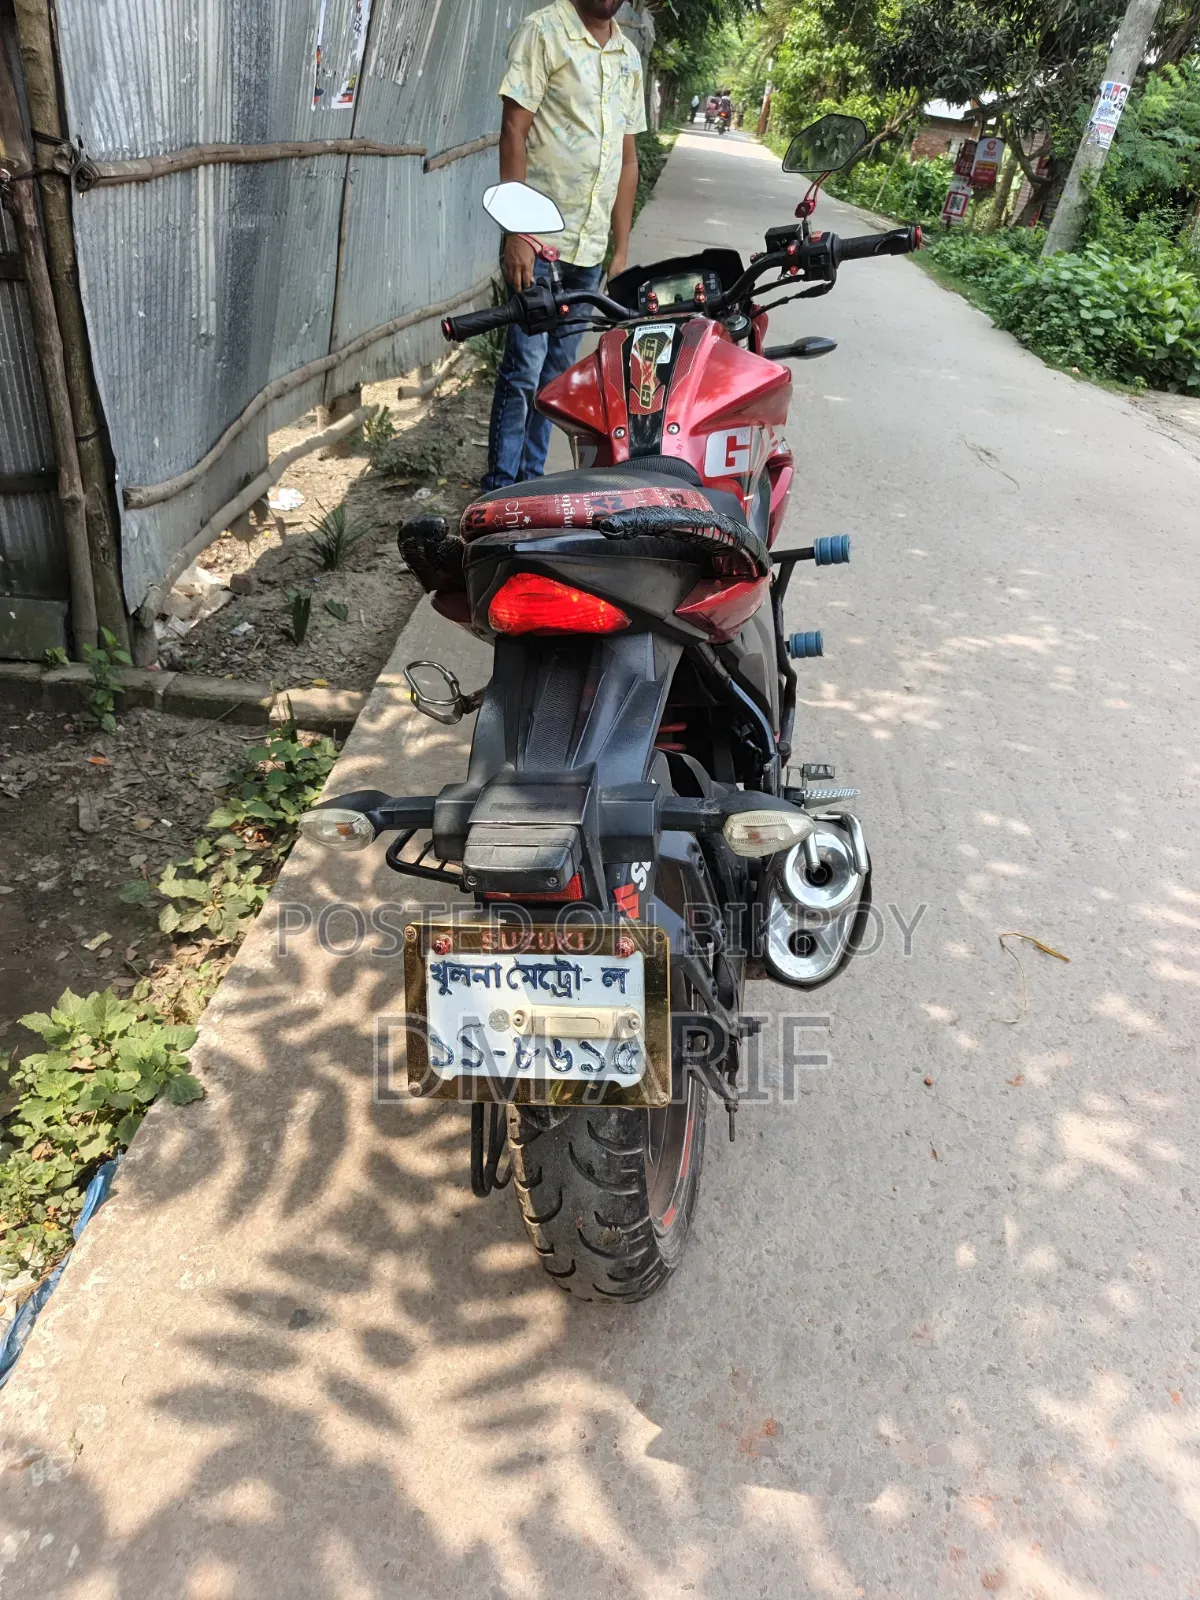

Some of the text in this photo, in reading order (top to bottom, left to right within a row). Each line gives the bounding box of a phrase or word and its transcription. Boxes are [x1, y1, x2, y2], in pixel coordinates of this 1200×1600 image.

[481, 930, 585, 951] SUZUKI
[430, 960, 502, 995] খুলনা
[601, 967, 631, 994] ল
